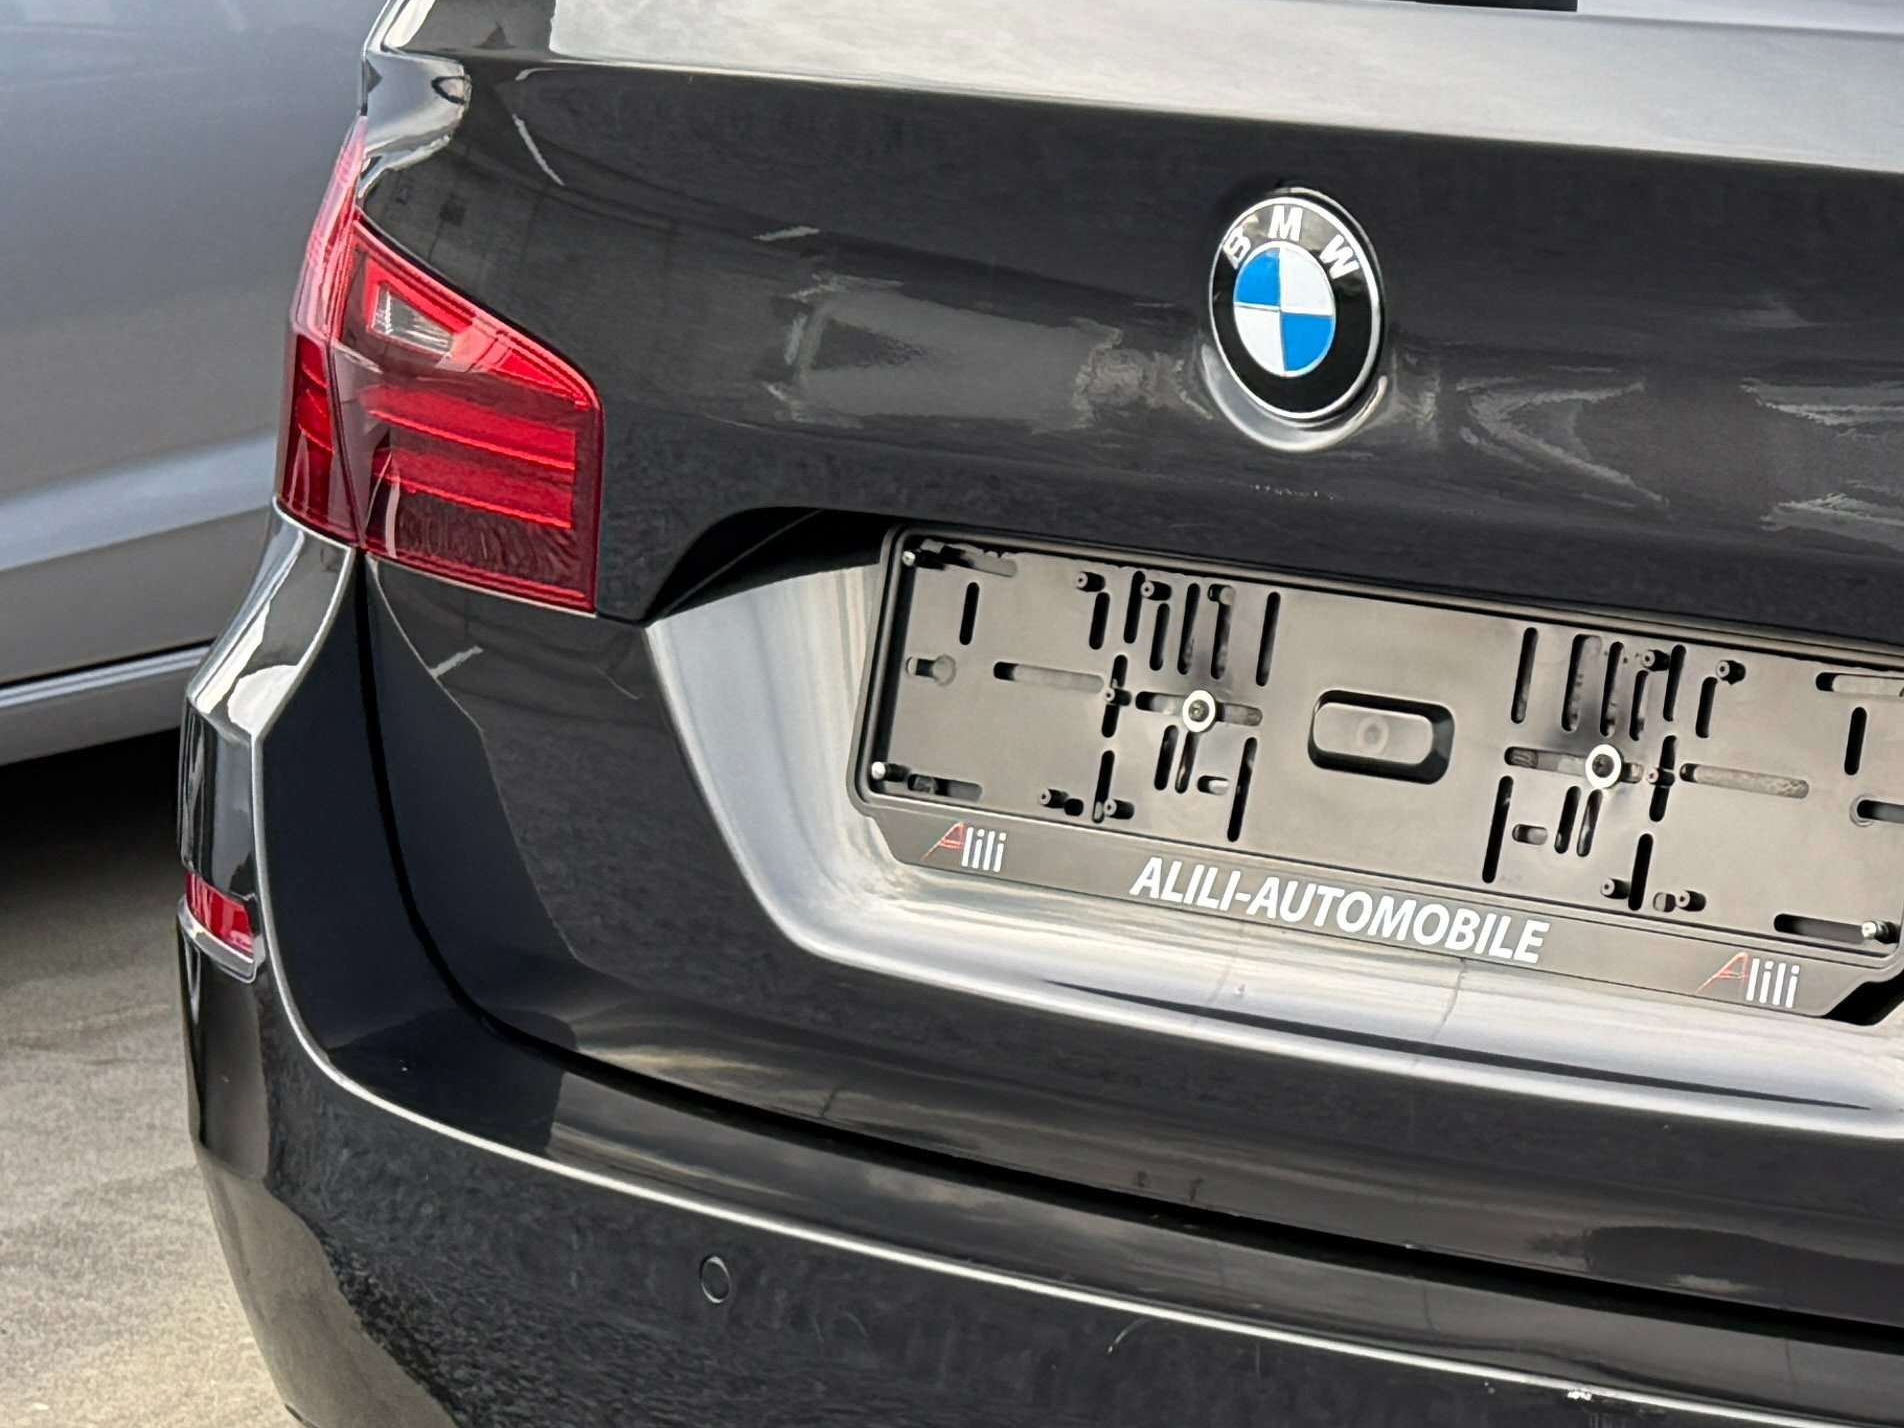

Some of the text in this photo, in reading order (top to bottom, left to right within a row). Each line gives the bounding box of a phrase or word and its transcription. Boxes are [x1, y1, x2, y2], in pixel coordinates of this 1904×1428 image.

[1222, 204, 1360, 280] BMW
[920, 821, 1007, 873] Alili
[1129, 856, 1551, 964] ALILI-AUTOMOBILE
[1695, 952, 1800, 1009] Alili
